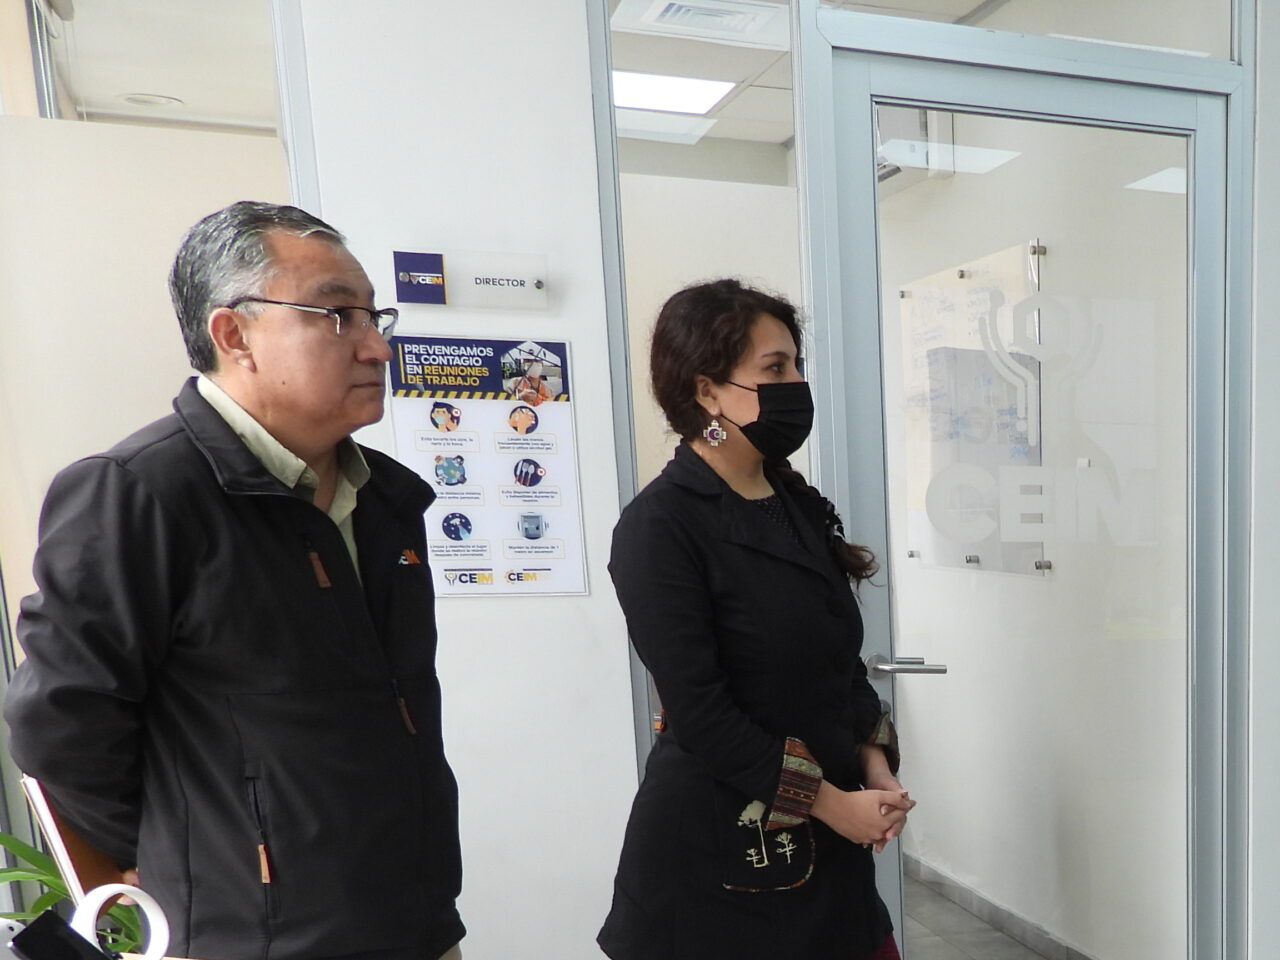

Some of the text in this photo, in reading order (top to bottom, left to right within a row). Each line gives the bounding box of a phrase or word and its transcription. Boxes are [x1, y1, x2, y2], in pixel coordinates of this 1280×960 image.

[475, 277, 526, 288] DIRECTOR
[404, 344, 494, 357] PREVENGAMOS
[405, 354, 482, 366] EL CONTAGIO
[406, 365, 490, 377] EN REUNIONES
[407, 375, 480, 386] DE TRABAJO
[459, 573, 493, 584] CEIM
